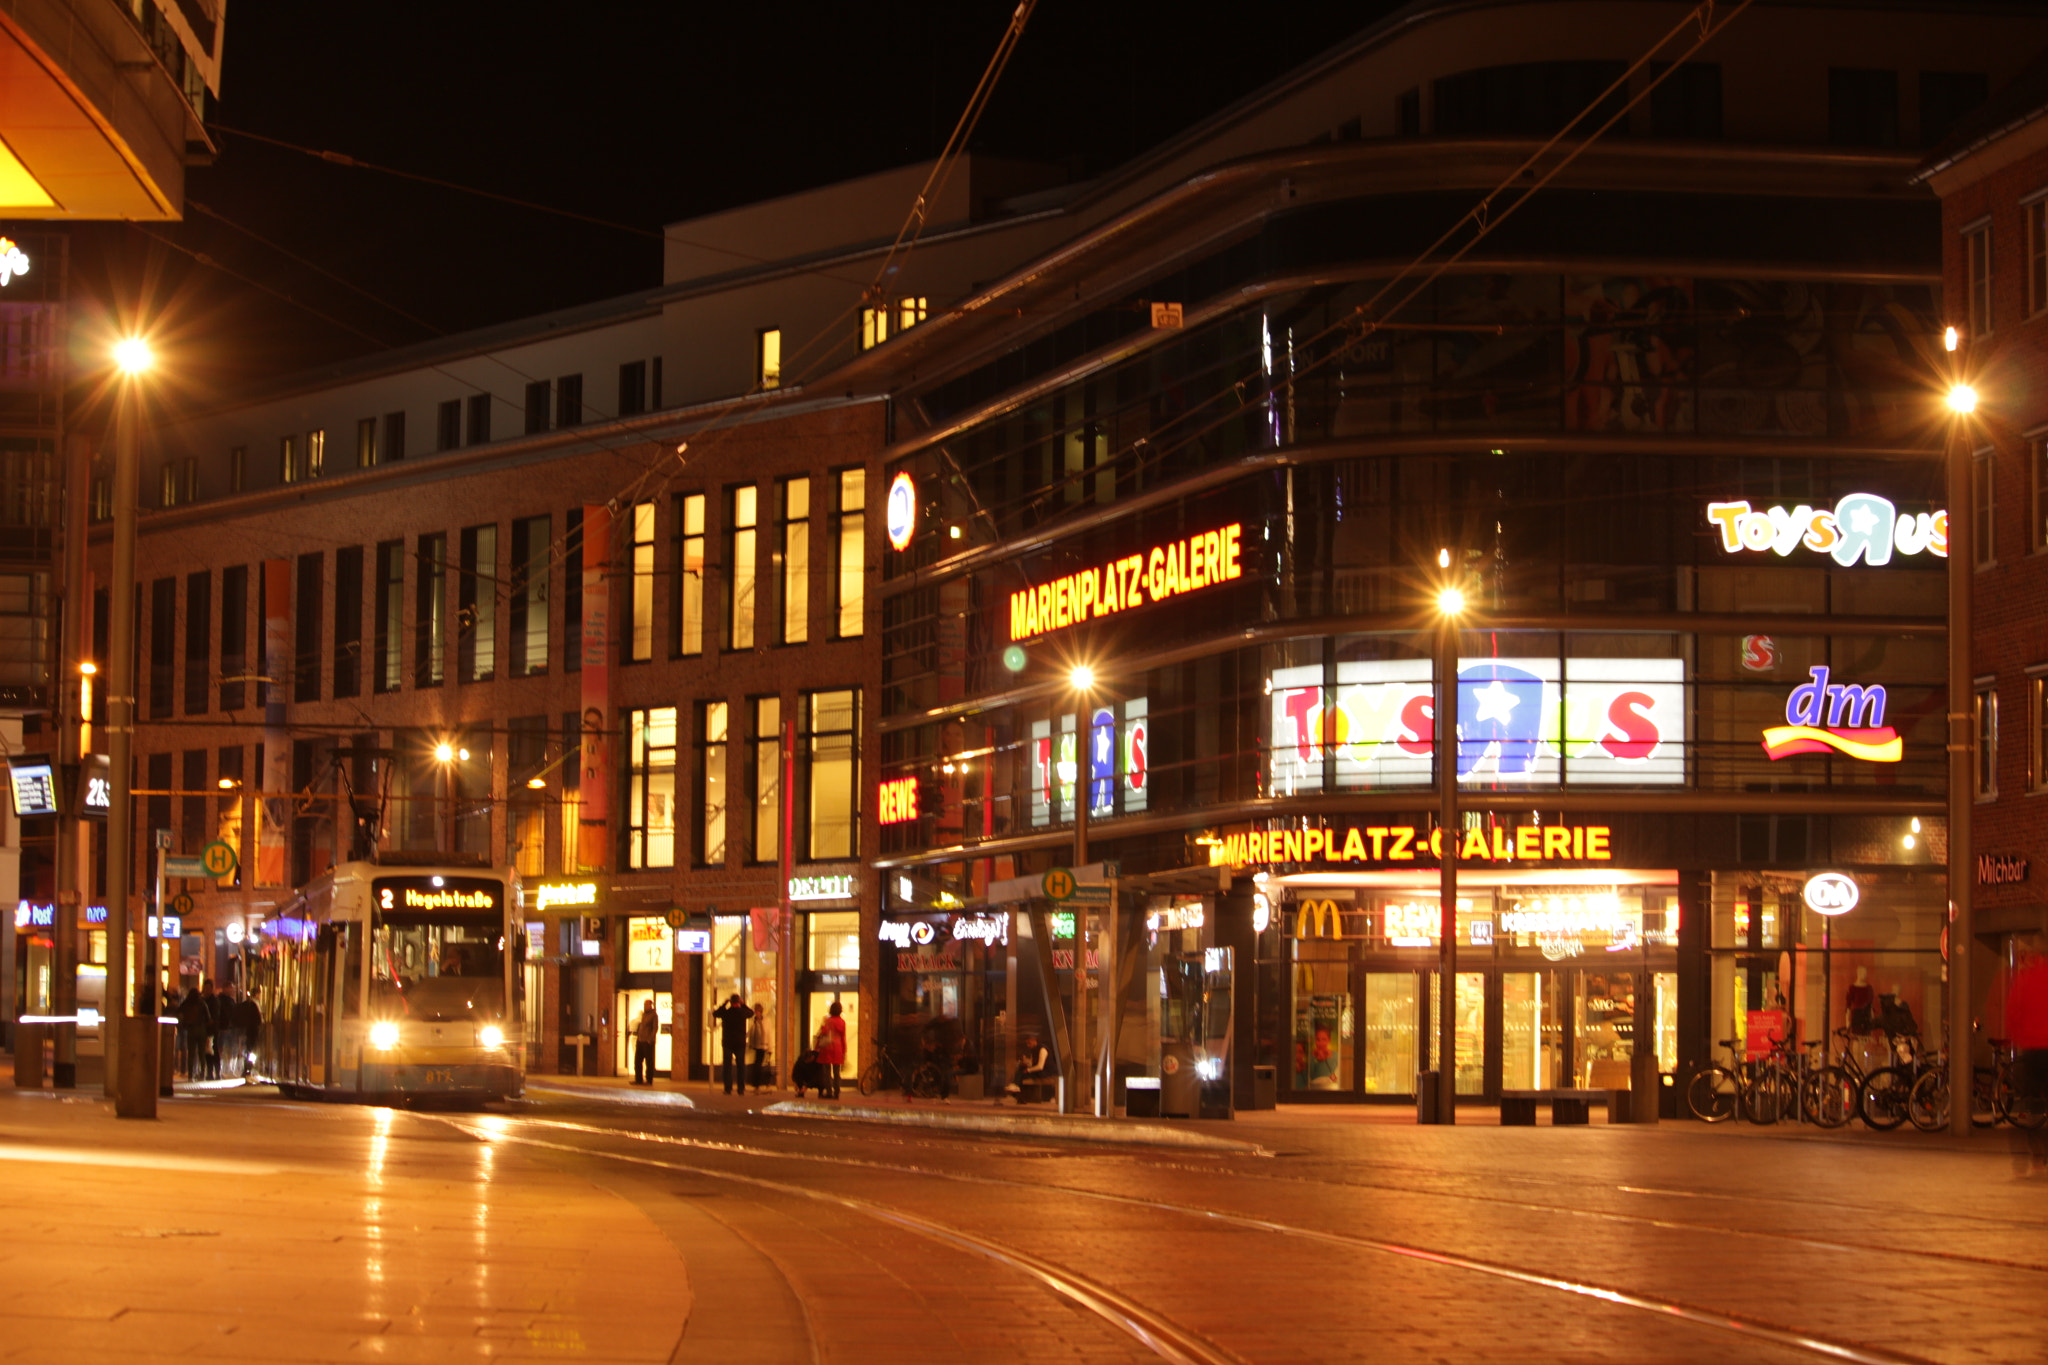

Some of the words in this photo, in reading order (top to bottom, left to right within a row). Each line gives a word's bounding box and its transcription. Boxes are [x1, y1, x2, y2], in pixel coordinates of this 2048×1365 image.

[1010, 523, 1242, 642] MARIENPLATZ-GALERIE
[1786, 666, 1887, 728] dm
[879, 776, 918, 826] REWE
[1979, 853, 2028, 886] Milchbar
[380, 887, 395, 910] 2
